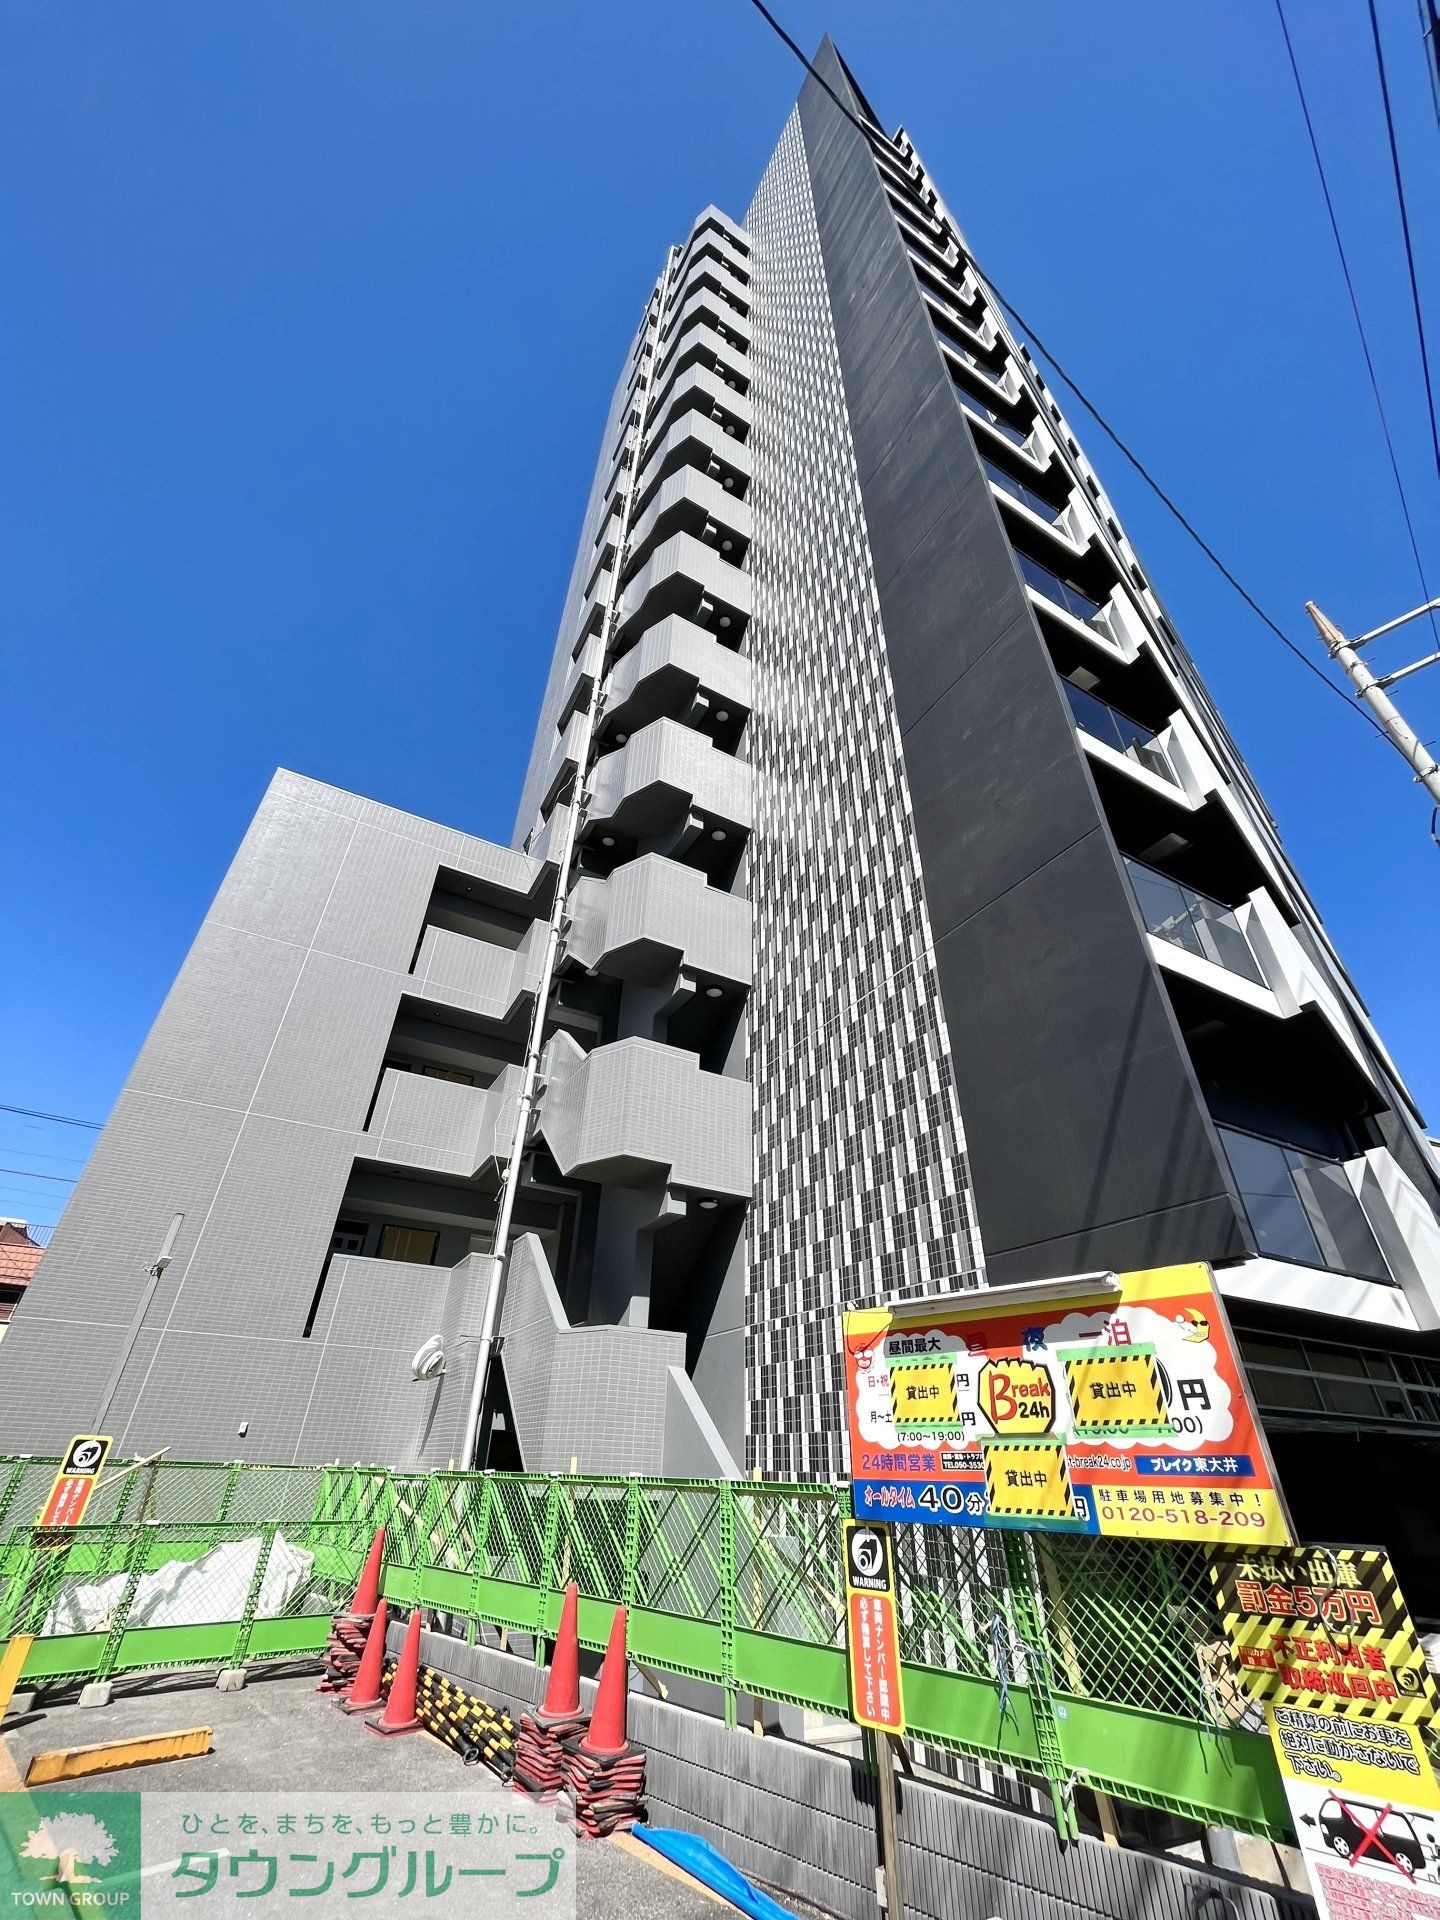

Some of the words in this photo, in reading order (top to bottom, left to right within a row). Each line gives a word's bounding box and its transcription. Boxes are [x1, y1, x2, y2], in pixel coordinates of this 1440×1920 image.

[1079, 1318, 1132, 1346] 一泊
[889, 1337, 941, 1356] 昼間最大
[906, 1385, 939, 1400] 貸出中
[989, 1370, 1051, 1425] Break
[1090, 1381, 1136, 1399] 貸出中
[1177, 1378, 1211, 1411] 円
[962, 1412, 976, 1426] 円
[1018, 1401, 1050, 1419] 24h
[862, 1454, 936, 1472] 24時間営業
[1151, 1457, 1238, 1473] ブレイク東大井
[1005, 1470, 1047, 1487] 貸出中
[864, 1485, 916, 1509] オールタイム
[1102, 1506, 1265, 1527] 0120-518-209
[852, 1575, 887, 1590] WARNING
[1235, 1579, 1383, 1626] 罰金5万円
[1270, 1634, 1388, 1672] 不正利用者
[1277, 1663, 1399, 1705] 取締巡回中
[1273, 1706, 1412, 1749] ご精算の前にお車を
[1280, 1730, 1420, 1774] 絶対に動かさないで
